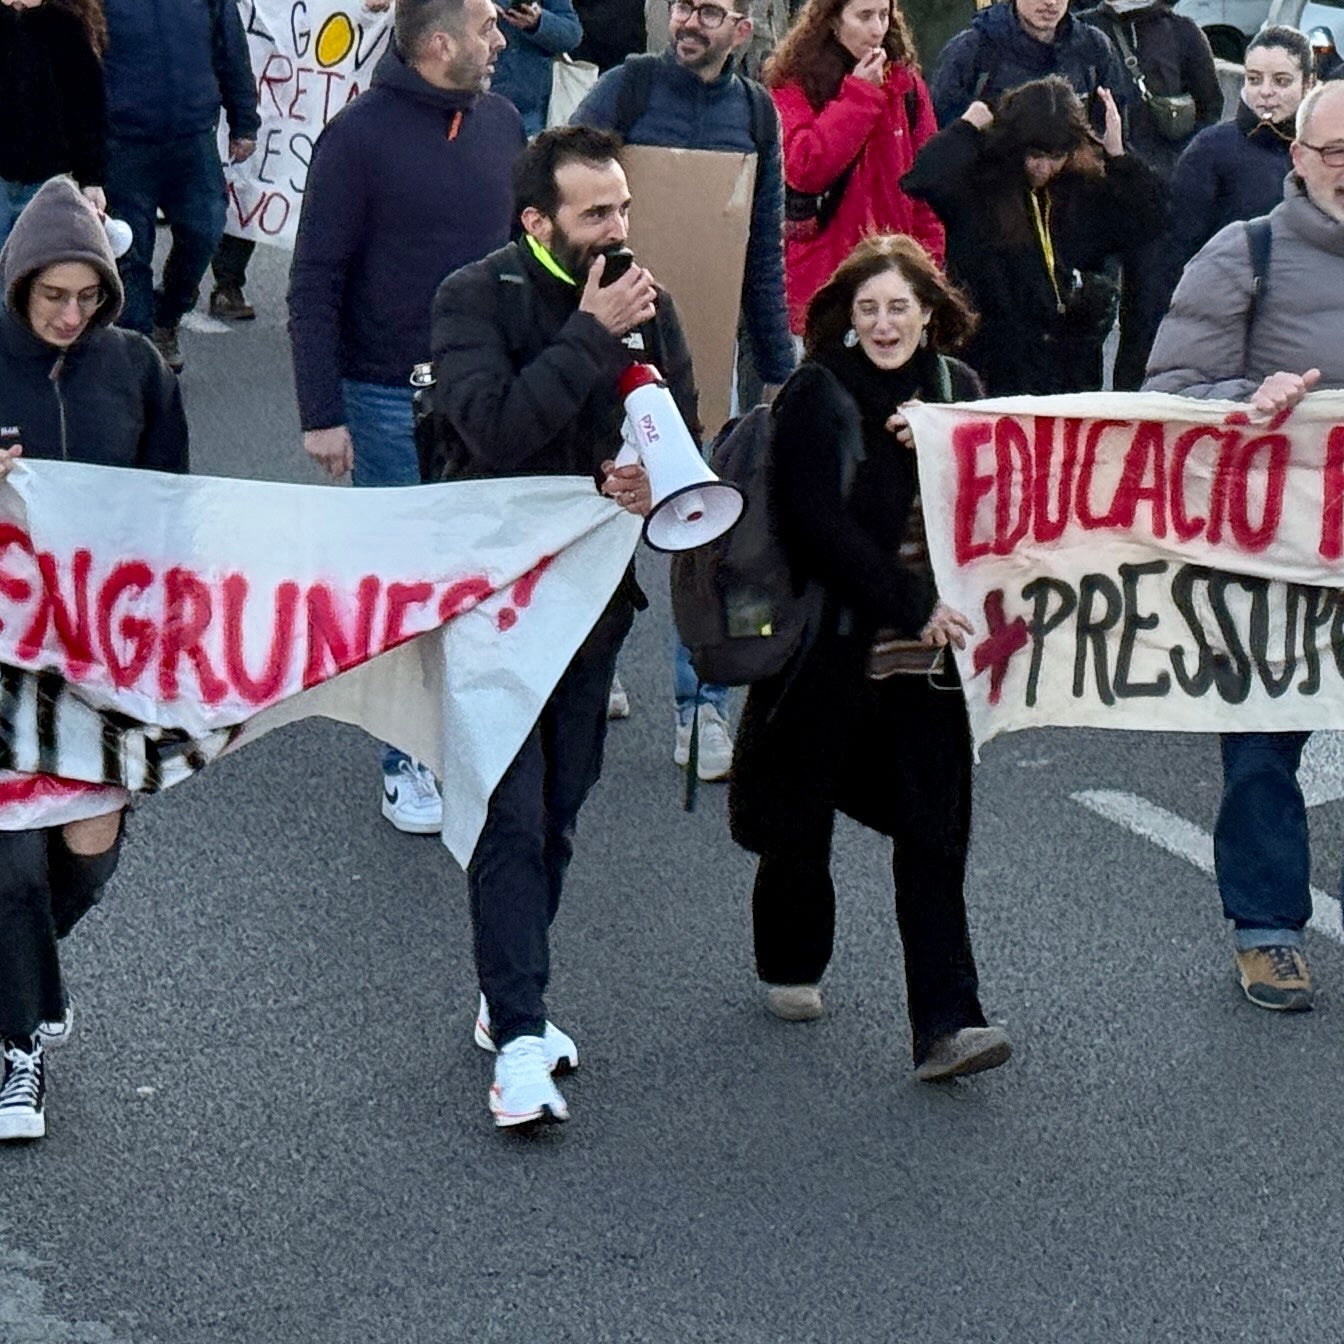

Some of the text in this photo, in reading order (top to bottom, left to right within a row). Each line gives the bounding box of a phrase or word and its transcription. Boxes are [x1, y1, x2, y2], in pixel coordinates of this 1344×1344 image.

[291, 0, 395, 70] GOV
[639, 413, 661, 444] PYLE
[953, 407, 1294, 565] EDUCACIÓ
